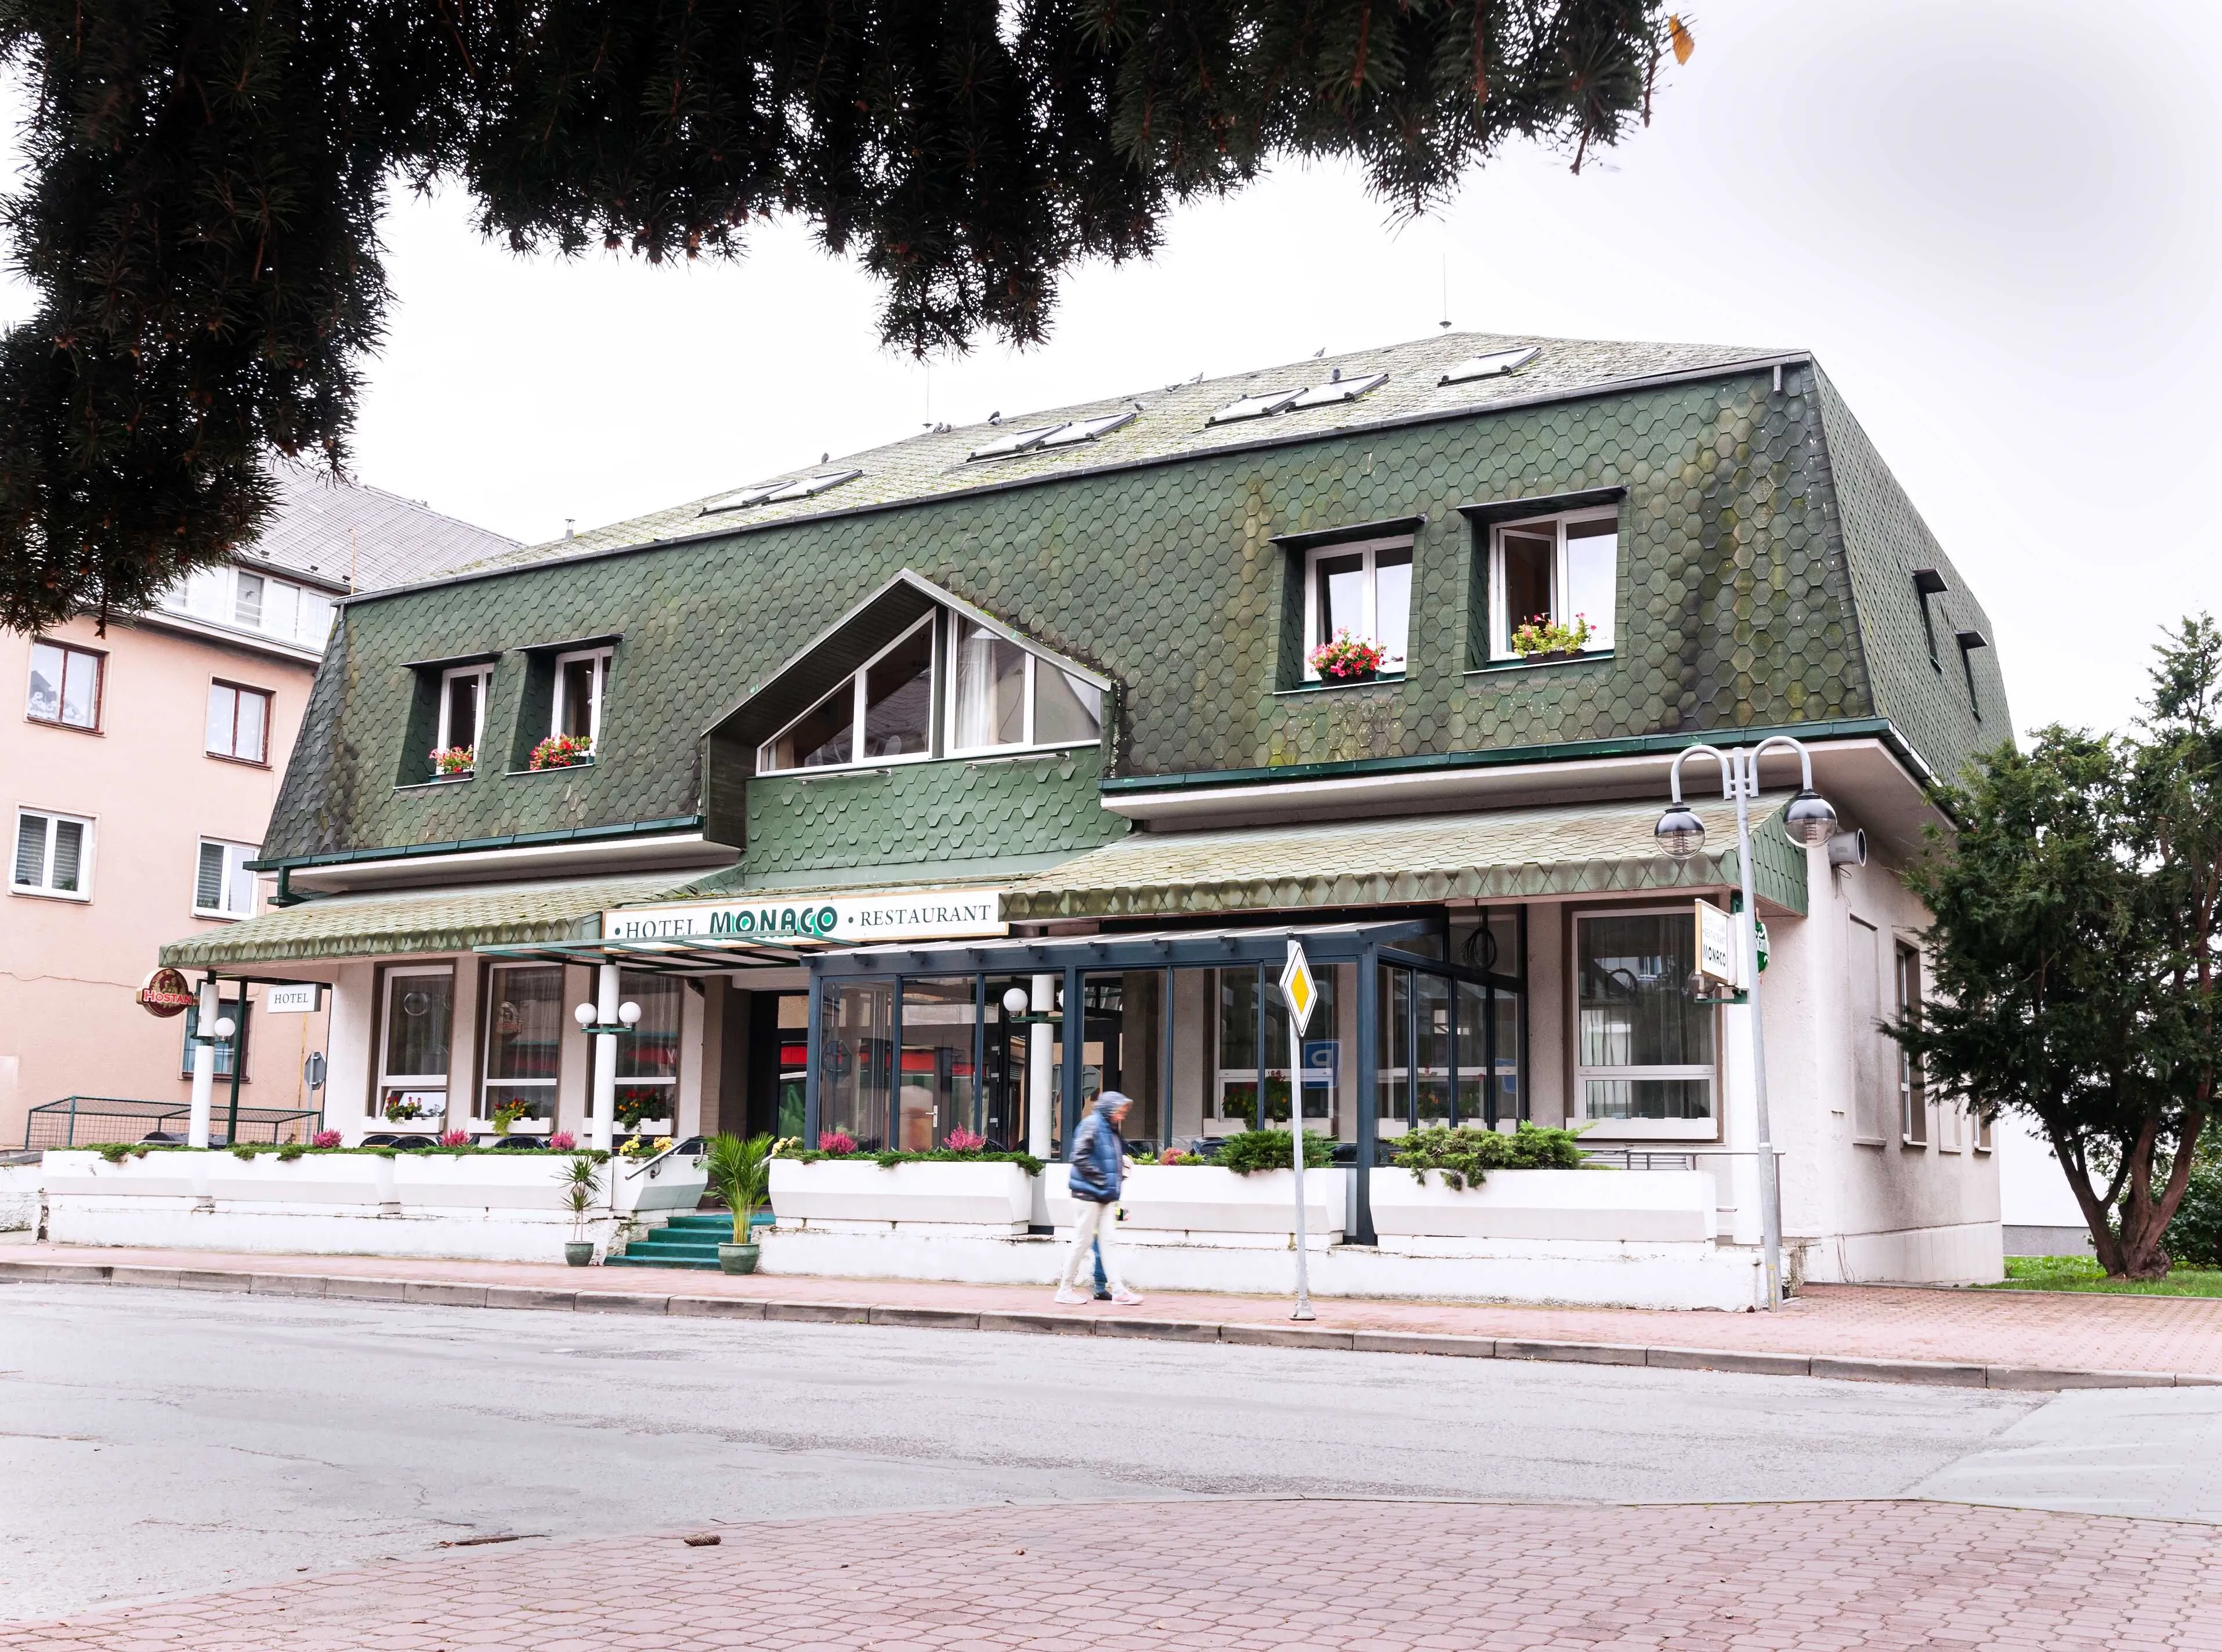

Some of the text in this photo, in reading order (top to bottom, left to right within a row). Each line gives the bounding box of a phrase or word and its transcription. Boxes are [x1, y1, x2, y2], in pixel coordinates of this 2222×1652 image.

[626, 905, 991, 938] HOTEL MONACO RESTAURANT
[1703, 943, 1727, 967] MONACO
[143, 989, 193, 1005] HOSTAN
[274, 992, 309, 1005] HOTEL
